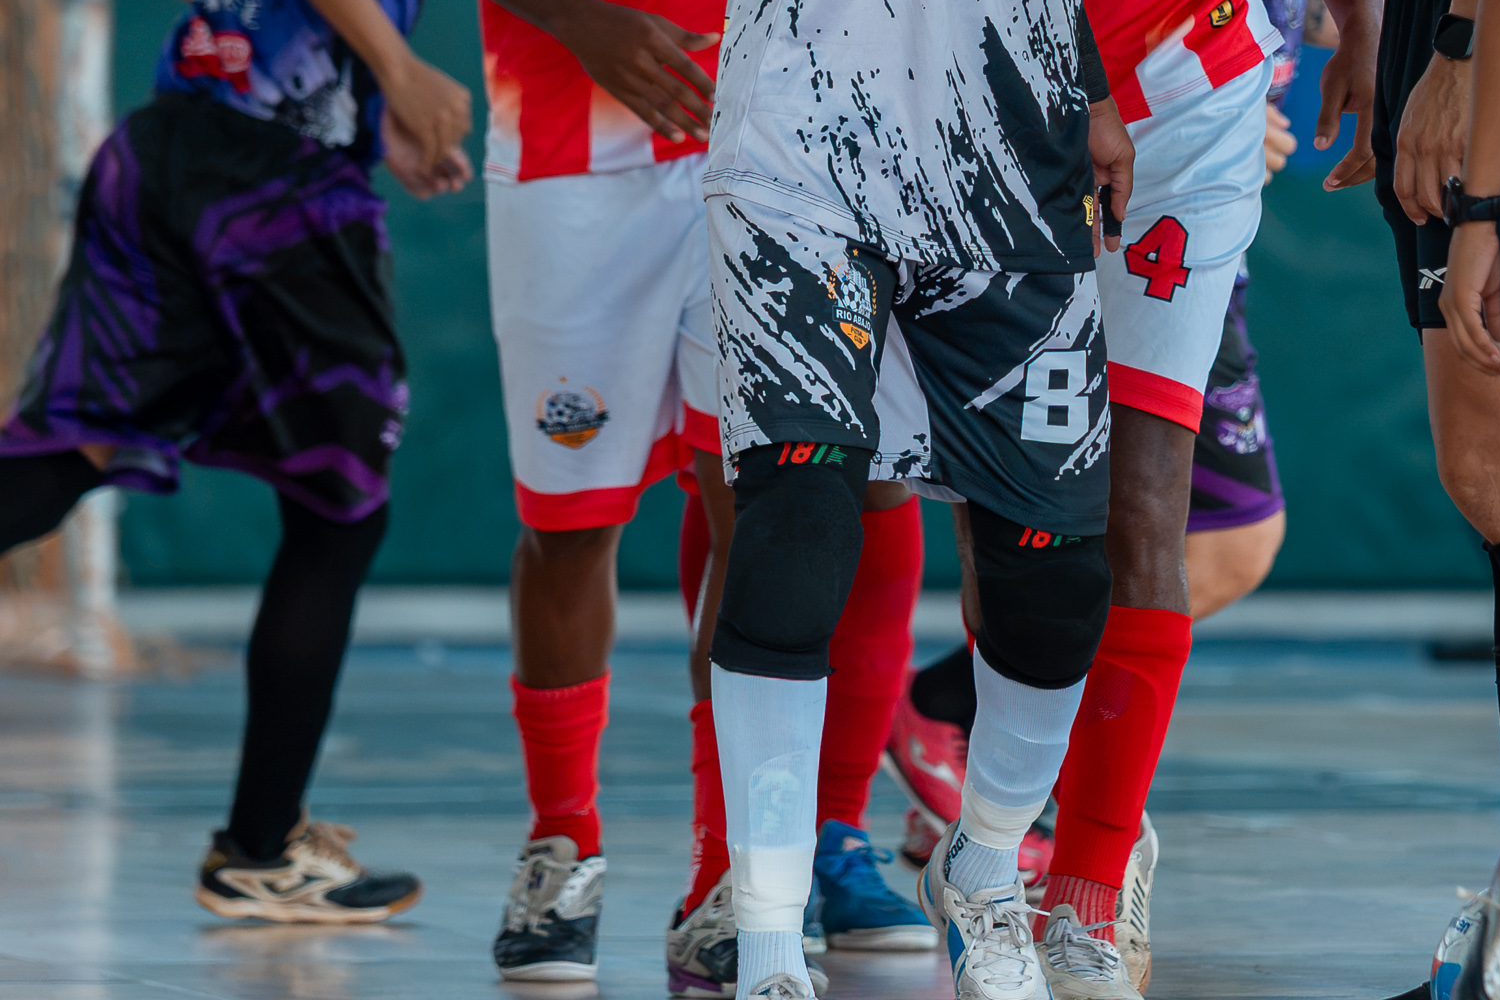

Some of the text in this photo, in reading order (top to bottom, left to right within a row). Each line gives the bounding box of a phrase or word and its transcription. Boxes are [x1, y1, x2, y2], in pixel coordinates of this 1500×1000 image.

[1123, 214, 1192, 303] 4
[836, 308, 871, 331] RIO ABAJO
[1021, 350, 1090, 445] 8
